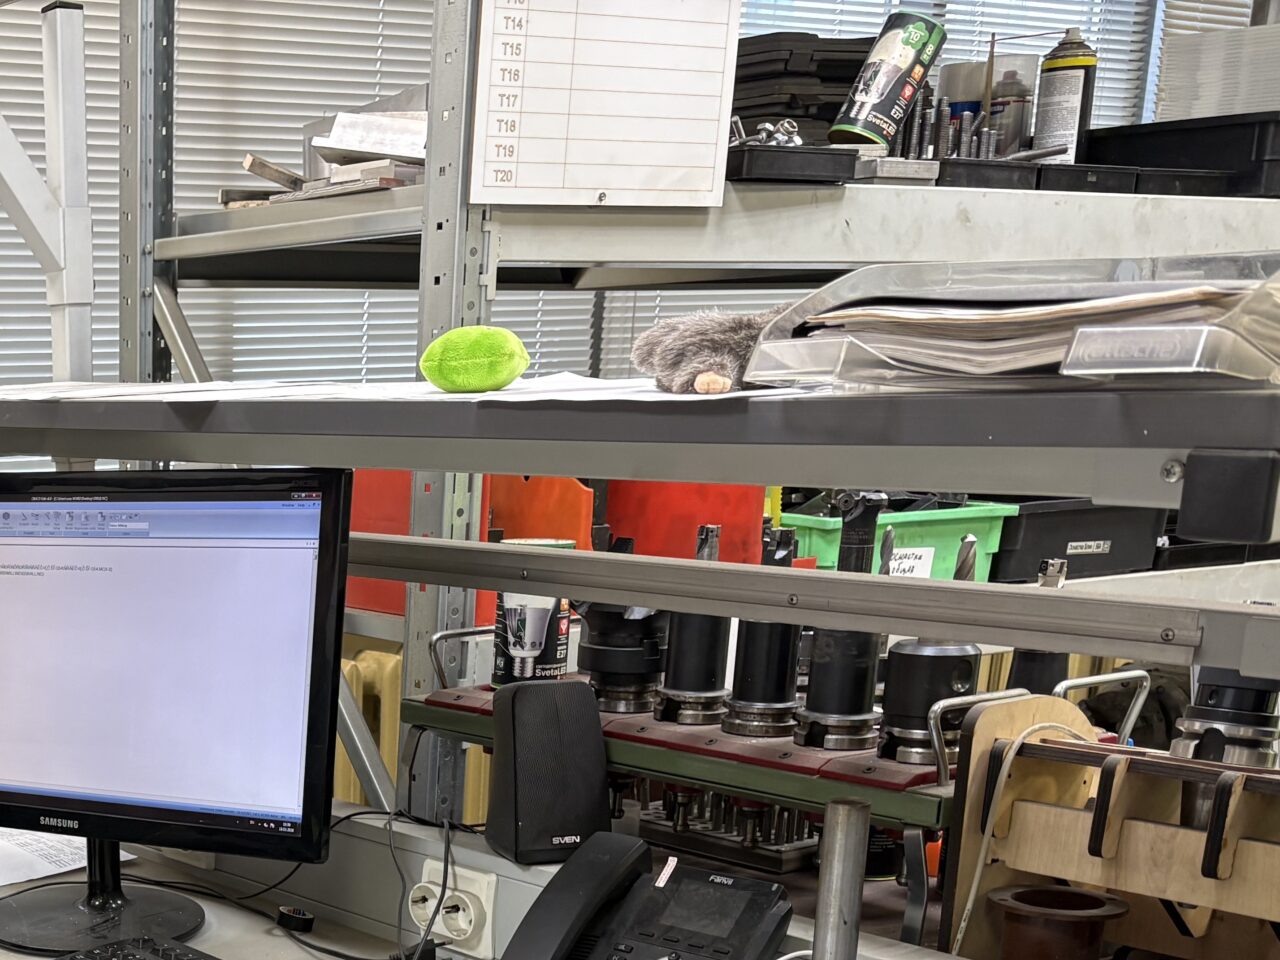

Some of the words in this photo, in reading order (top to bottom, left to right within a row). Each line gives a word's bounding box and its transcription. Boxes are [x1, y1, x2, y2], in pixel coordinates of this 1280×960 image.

[503, 16, 523, 31] T14
[502, 42, 522, 56] T15
[500, 68, 520, 82] T16
[498, 93, 518, 107] T17
[496, 119, 516, 133] T18
[495, 144, 515, 158] T19
[493, 169, 513, 183] T20
[39, 816, 79, 829] SAMSUNG
[552, 835, 581, 845] SVEN
